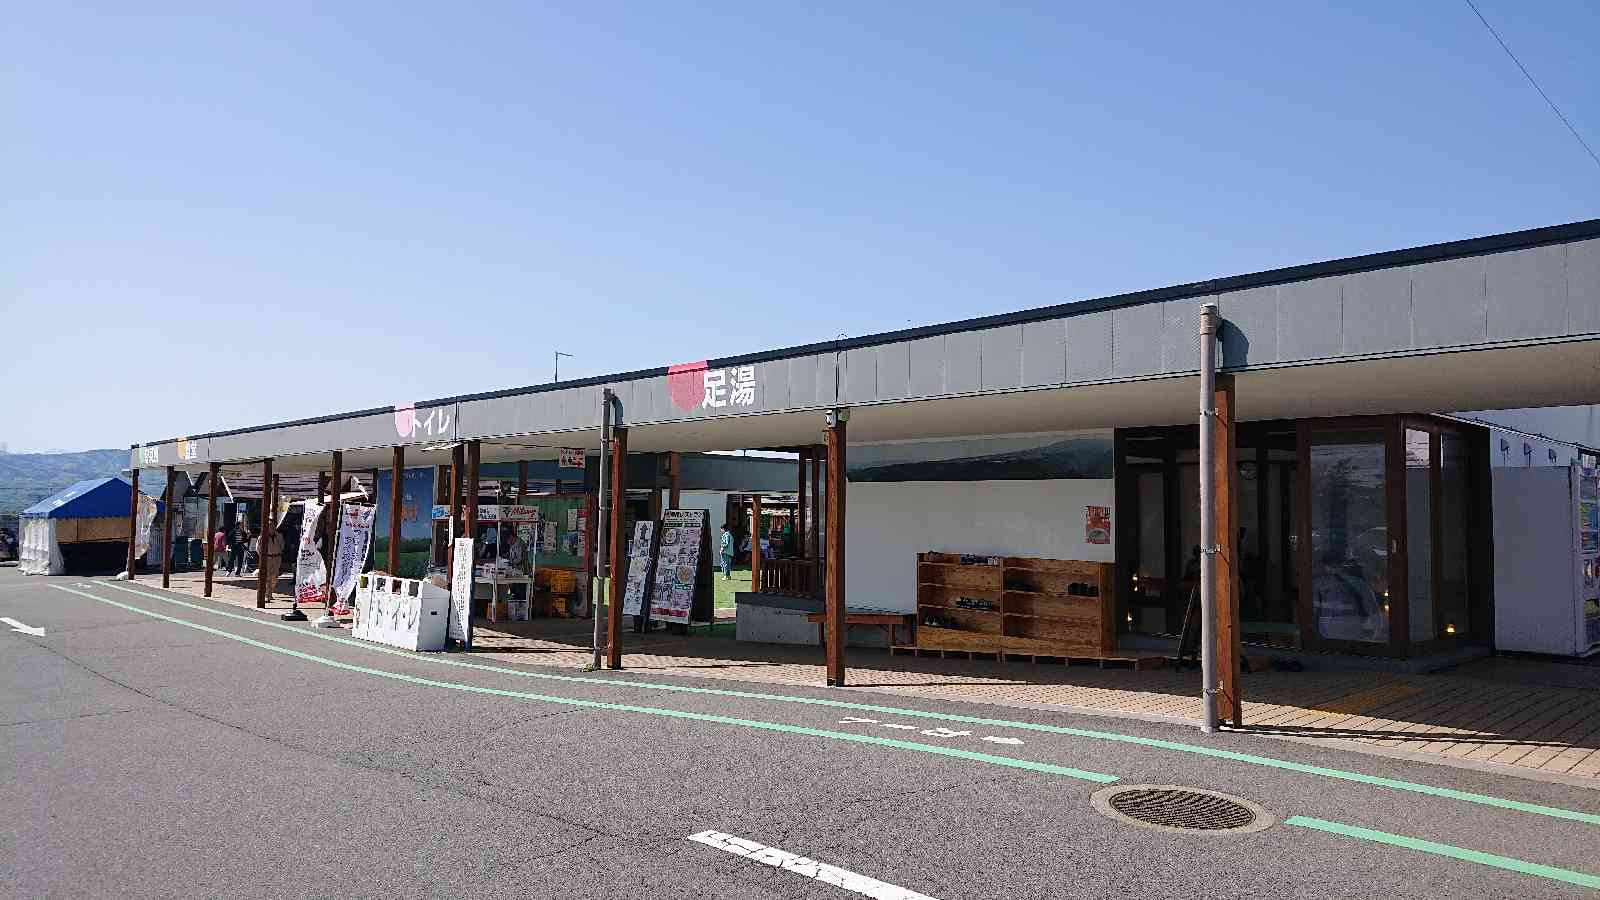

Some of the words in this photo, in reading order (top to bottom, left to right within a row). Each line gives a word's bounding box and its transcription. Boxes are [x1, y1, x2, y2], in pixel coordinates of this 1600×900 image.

[702, 366, 755, 408] 足湯
[411, 409, 450, 438] トイレ
